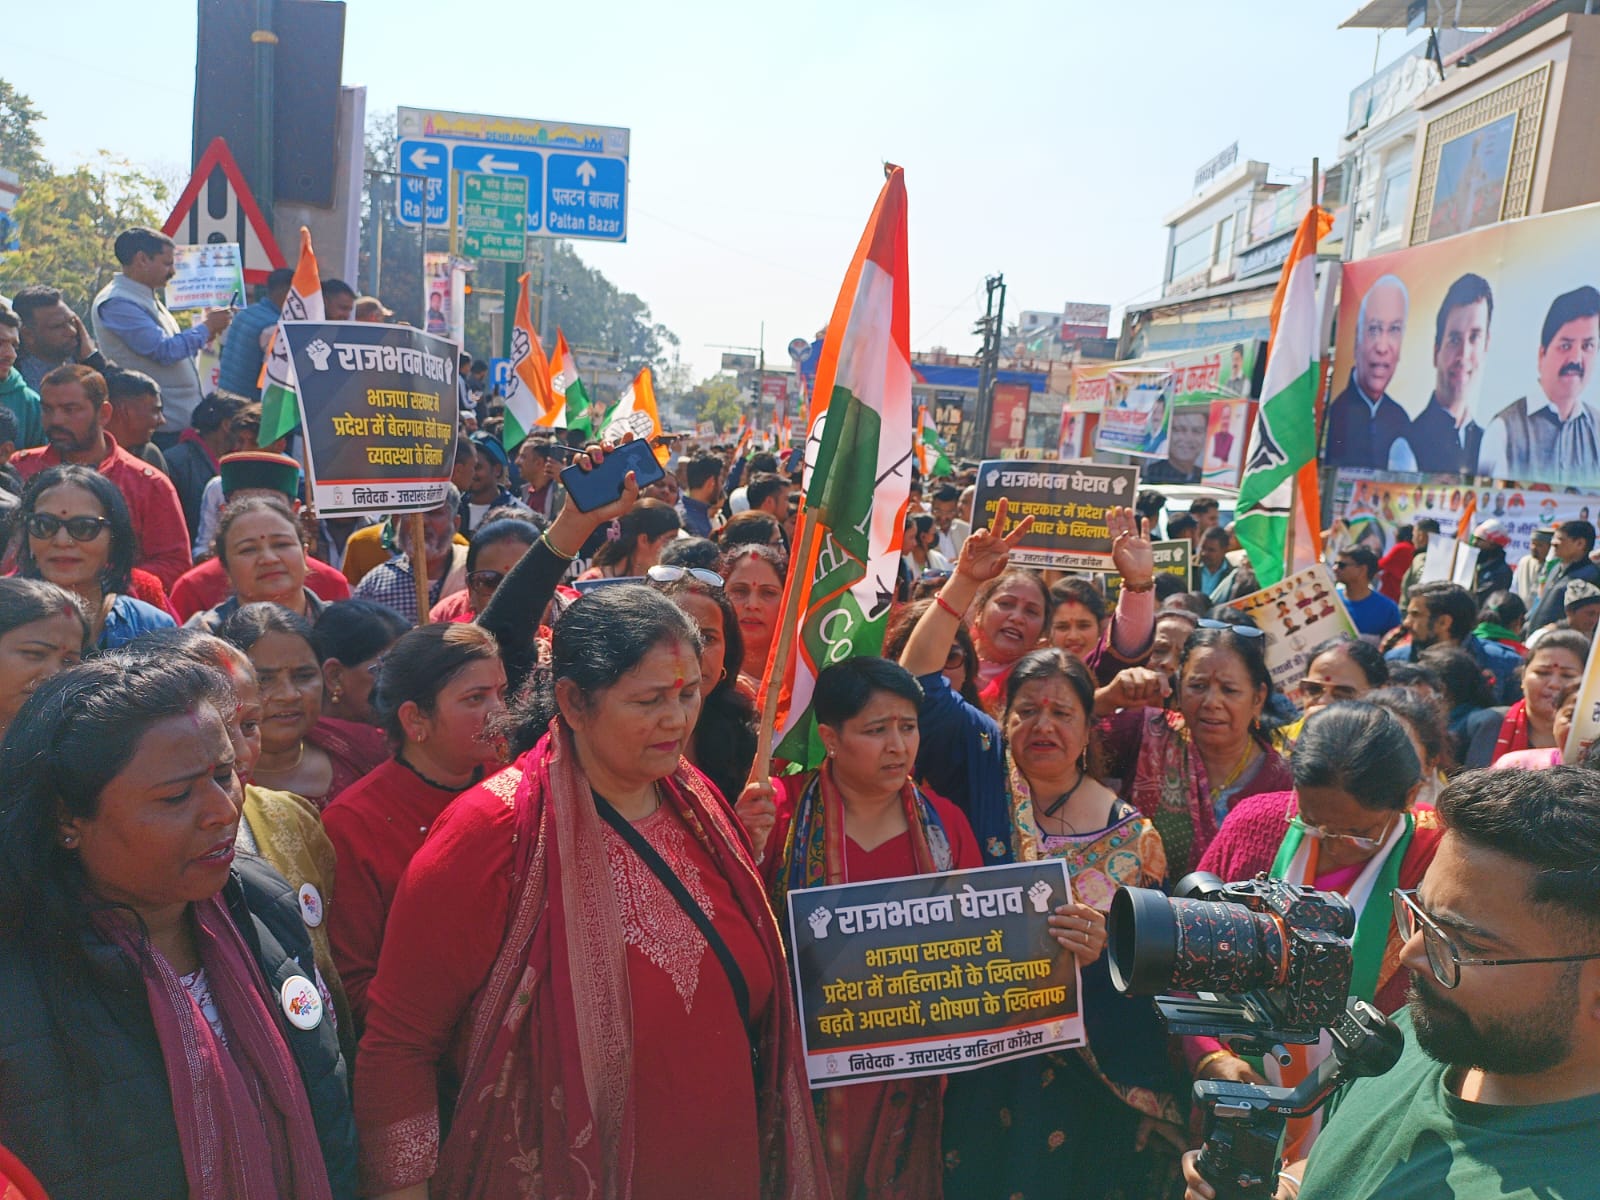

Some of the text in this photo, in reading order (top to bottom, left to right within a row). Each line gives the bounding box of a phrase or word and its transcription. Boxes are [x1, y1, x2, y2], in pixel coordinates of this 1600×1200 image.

[552, 187, 585, 208] पलटन
[550, 211, 585, 230] Paltan
[588, 214, 620, 233] Bazar
[333, 342, 445, 382] राजभवन घेराव
[366, 388, 409, 409] भाजपा
[409, 391, 434, 412] सरकार
[332, 412, 369, 437] प्रदेश
[369, 412, 385, 437] में
[387, 414, 424, 437] बेलगाम
[366, 446, 414, 466] व्यवस्था
[415, 442, 424, 465] के
[1001, 469, 1112, 494] राजभवन घेराव
[352, 487, 389, 504] निवेदक
[985, 500, 1019, 514] भापा
[1021, 502, 1062, 516] सरकार
[1064, 501, 1076, 518] में
[1077, 504, 1103, 520] प्रदेश
[1056, 519, 1067, 536] के
[1055, 554, 1079, 566] महिला
[835, 883, 1024, 934] राजभवन घेराव
[865, 929, 1004, 968] भाजपा सरकार में
[822, 958, 1052, 1004] प्रदेश में महिलाओं के खिलाफ
[818, 985, 1067, 1038] बढ़ते अपराधों, शोषण के खिलाफ
[848, 1052, 895, 1073] निवेदक
[906, 1042, 961, 1066] उत्तराखंड
[964, 1038, 1005, 1058] महिला
[1007, 1027, 1044, 1050] काँग्रेस
